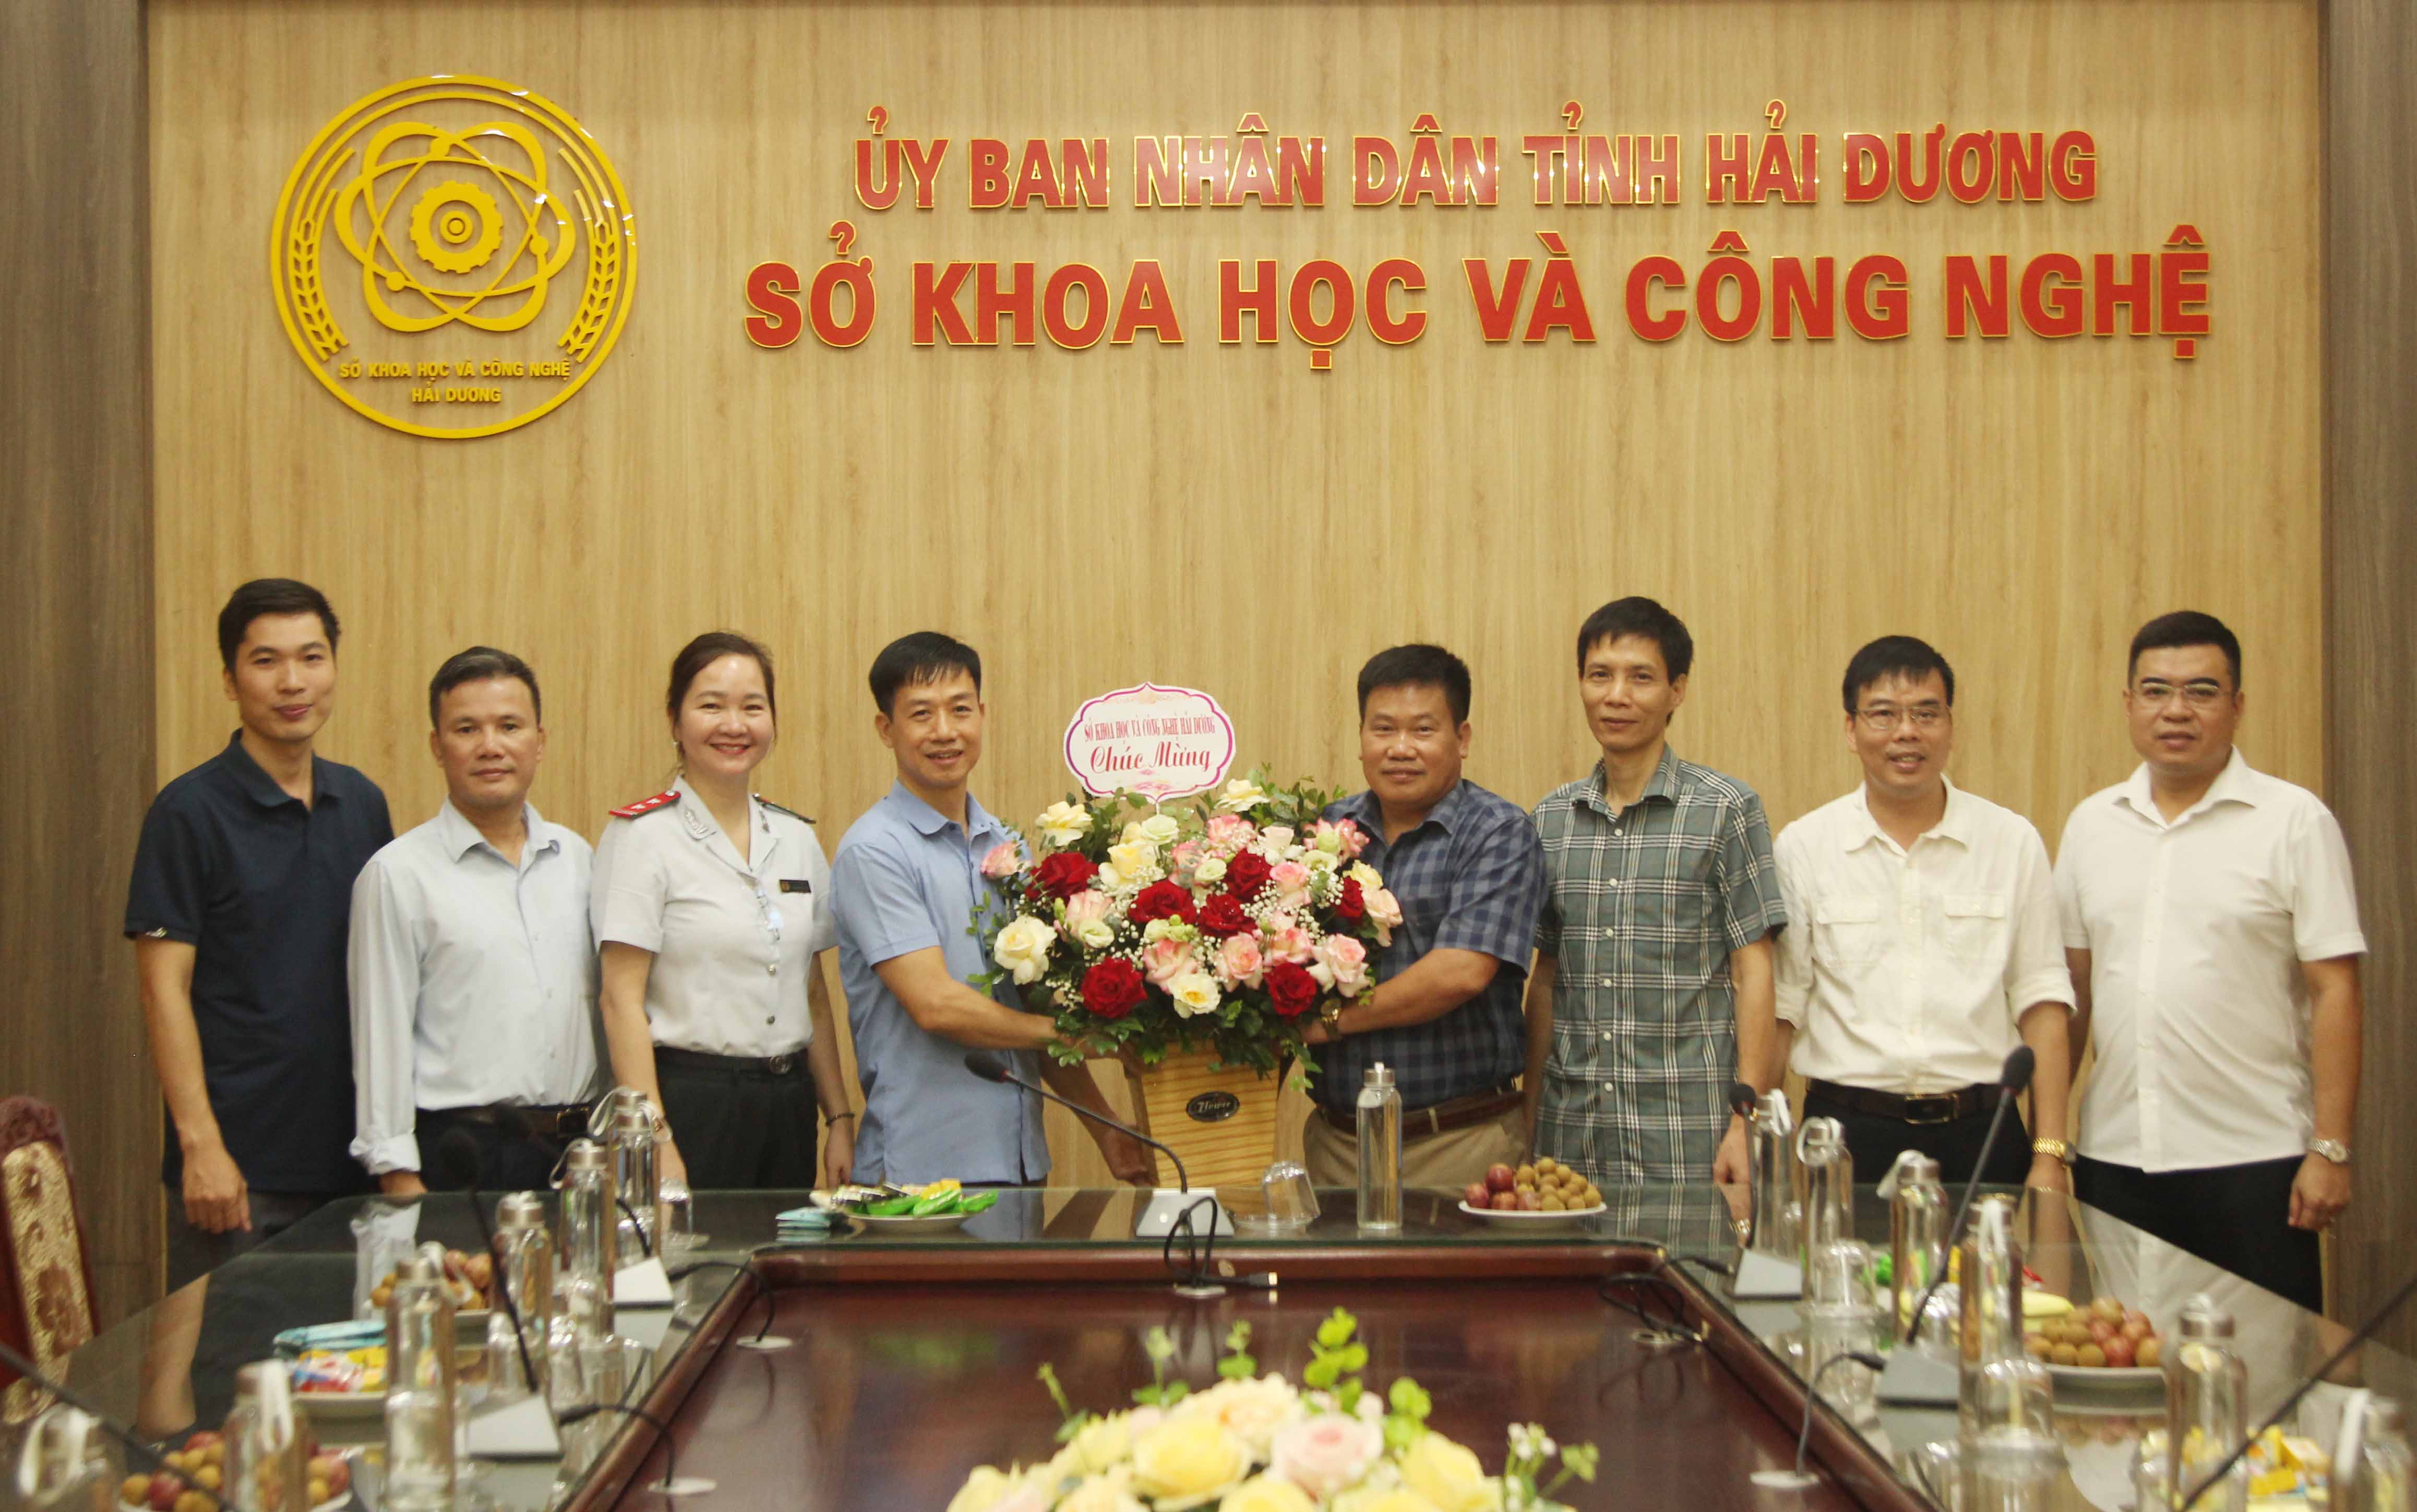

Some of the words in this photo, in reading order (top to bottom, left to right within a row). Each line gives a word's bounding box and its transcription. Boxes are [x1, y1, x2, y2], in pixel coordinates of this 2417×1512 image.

[854, 105, 950, 210] ỦY
[969, 138, 1110, 208] BAN
[1133, 113, 1326, 207] NHÂN
[1353, 113, 1498, 206] DÂN
[1523, 101, 1681, 205] TỈNH
[1705, 99, 1818, 203] HẢI
[1843, 123, 2097, 203] DƯƠNG
[745, 220, 877, 348] SỞ
[912, 259, 1184, 349] KHOA
[1218, 258, 1428, 370] HỌC
[1462, 231, 1597, 342] VÀ
[1624, 230, 1910, 342] CÔNG
[1945, 224, 2210, 359] NGHỆ
[368, 362, 412, 378] KHOA
[418, 362, 450, 382] HỌC
[455, 356, 476, 377] VÀ
[480, 357, 524, 377] CÔNG
[529, 357, 570, 381] NGHỆ
[412, 381, 440, 403] HẢI
[1095, 723, 1115, 741] KHOA
[1090, 746, 1144, 773] Chúc
[1149, 741, 1211, 772] Mừng
